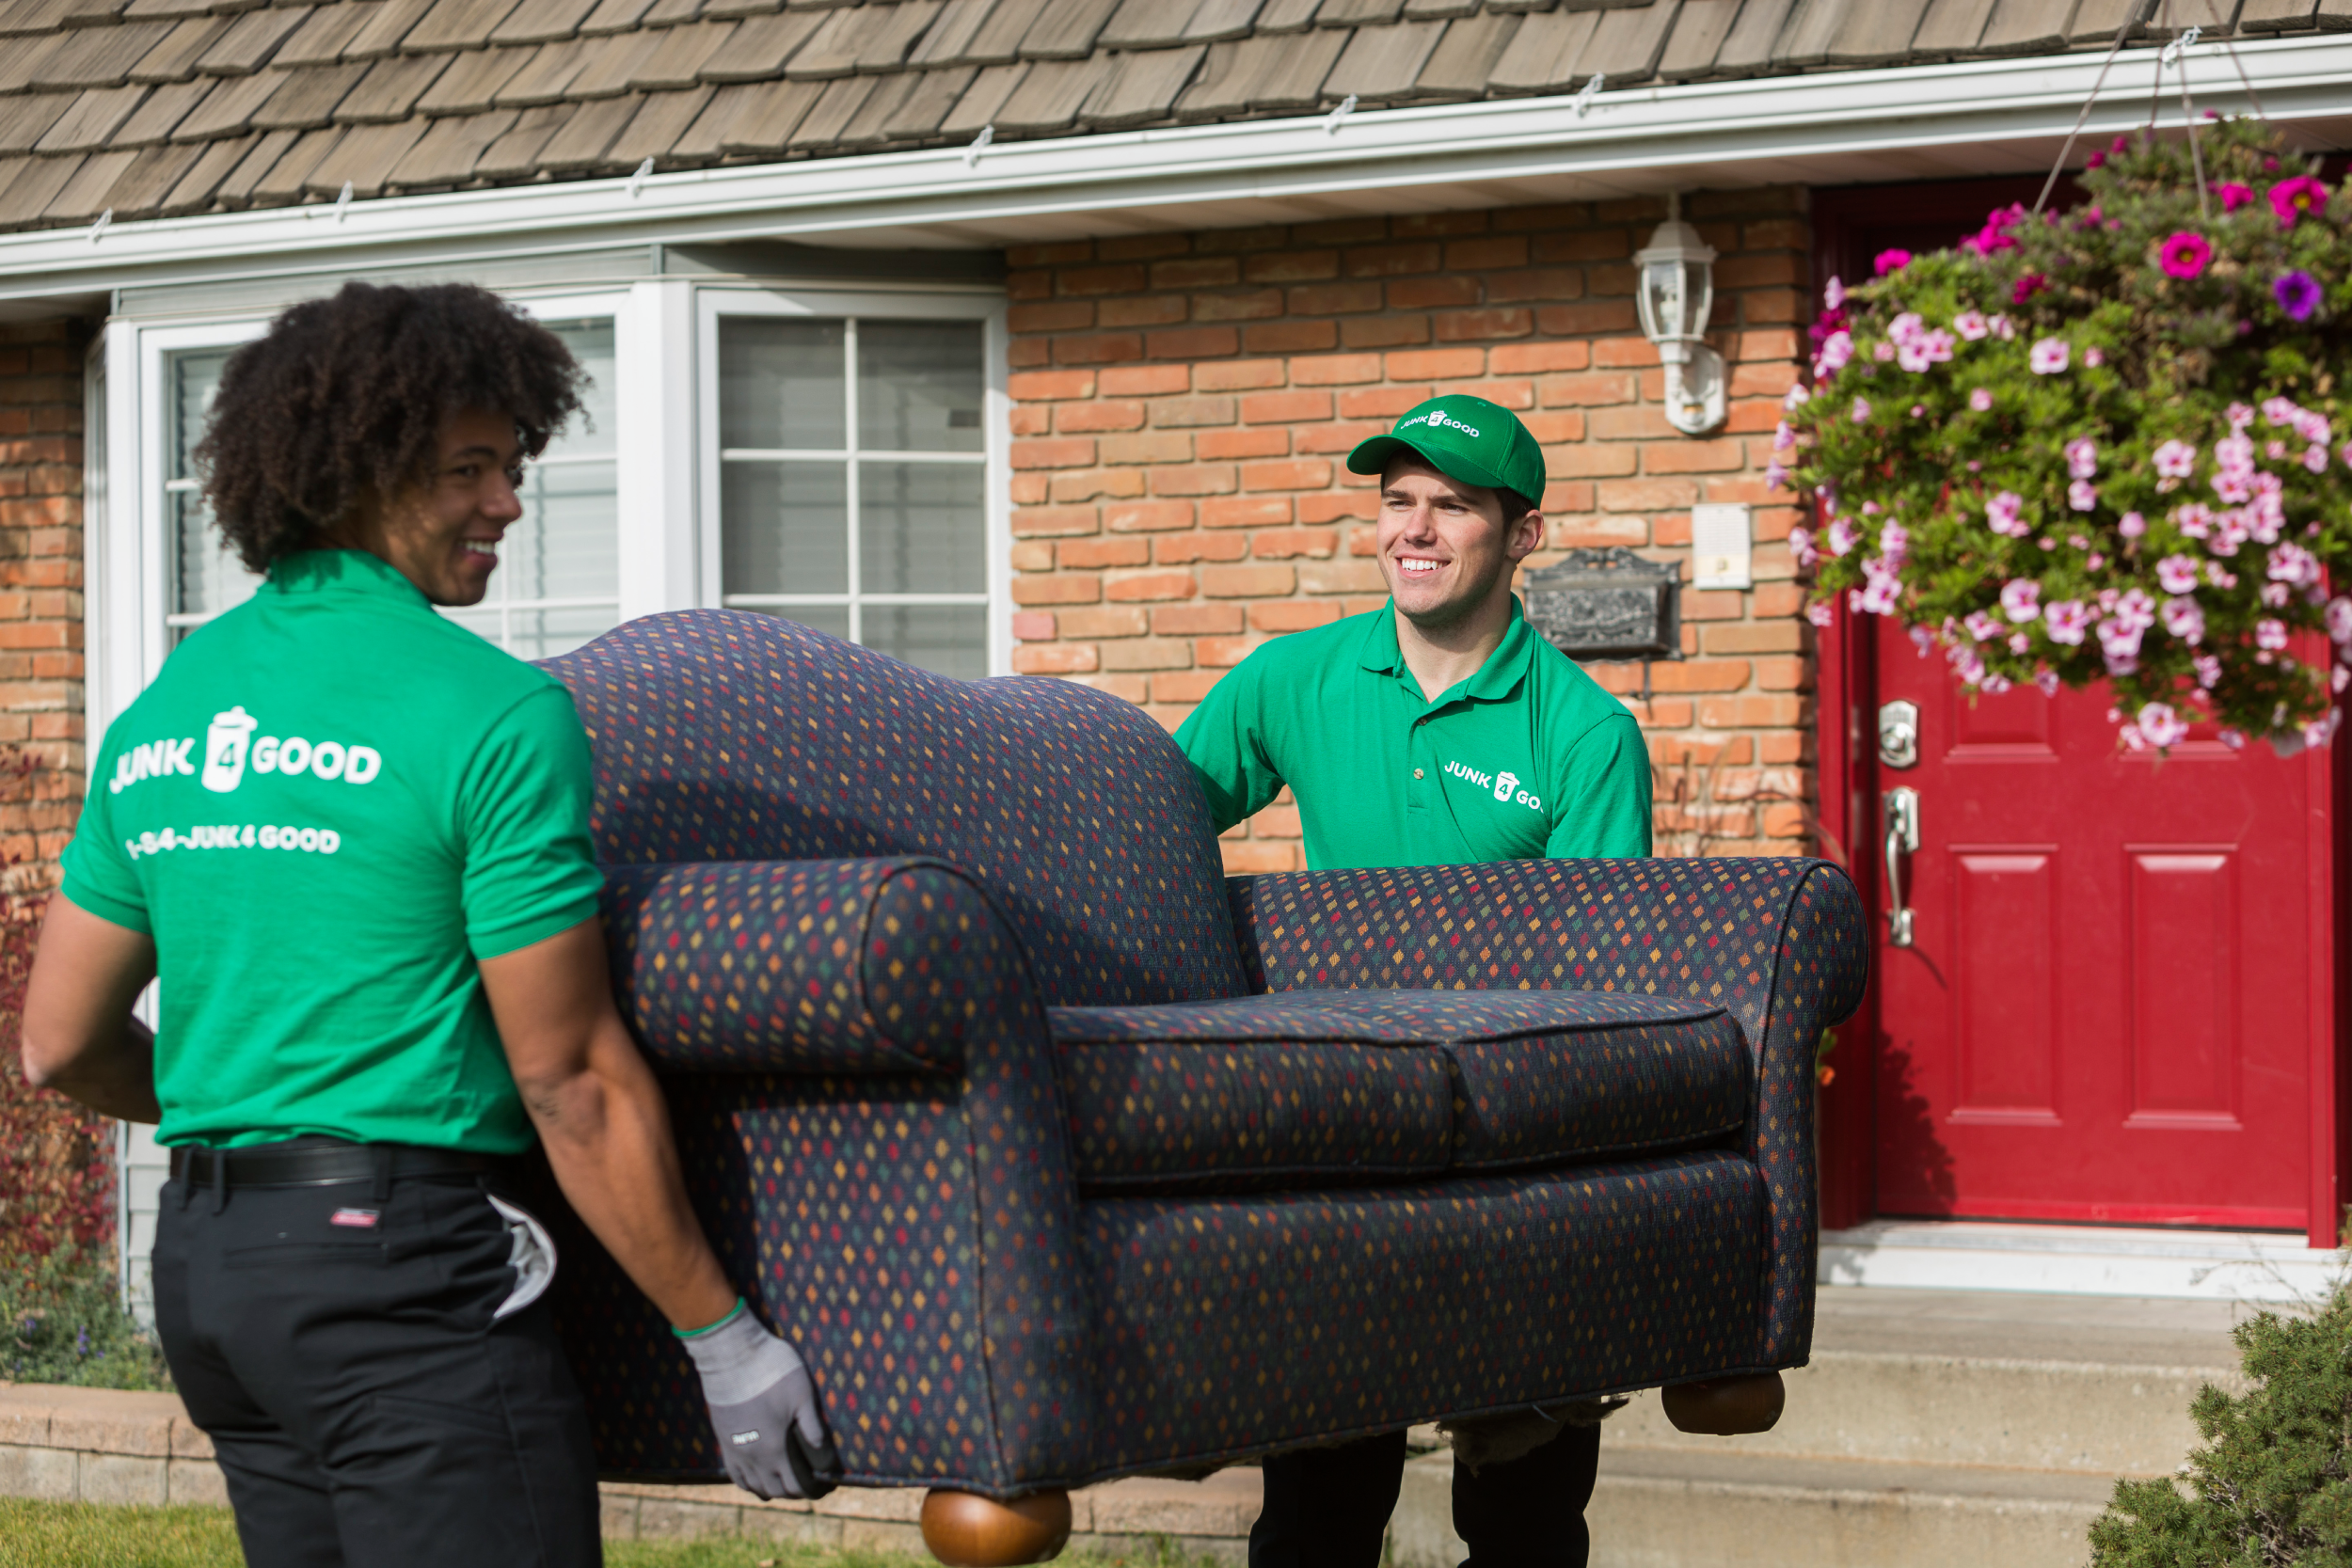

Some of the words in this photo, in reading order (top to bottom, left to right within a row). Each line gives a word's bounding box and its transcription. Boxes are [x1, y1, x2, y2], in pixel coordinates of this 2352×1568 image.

[1400, 415, 1428, 429] JUNK
[1442, 419, 1479, 437] GOOD
[109, 736, 196, 794] JUNK
[216, 741, 237, 773] 4
[251, 735, 382, 784] GOOD
[1444, 760, 1492, 789] JUNK
[1499, 784, 1509, 796] 4
[1516, 790, 1544, 814] GO
